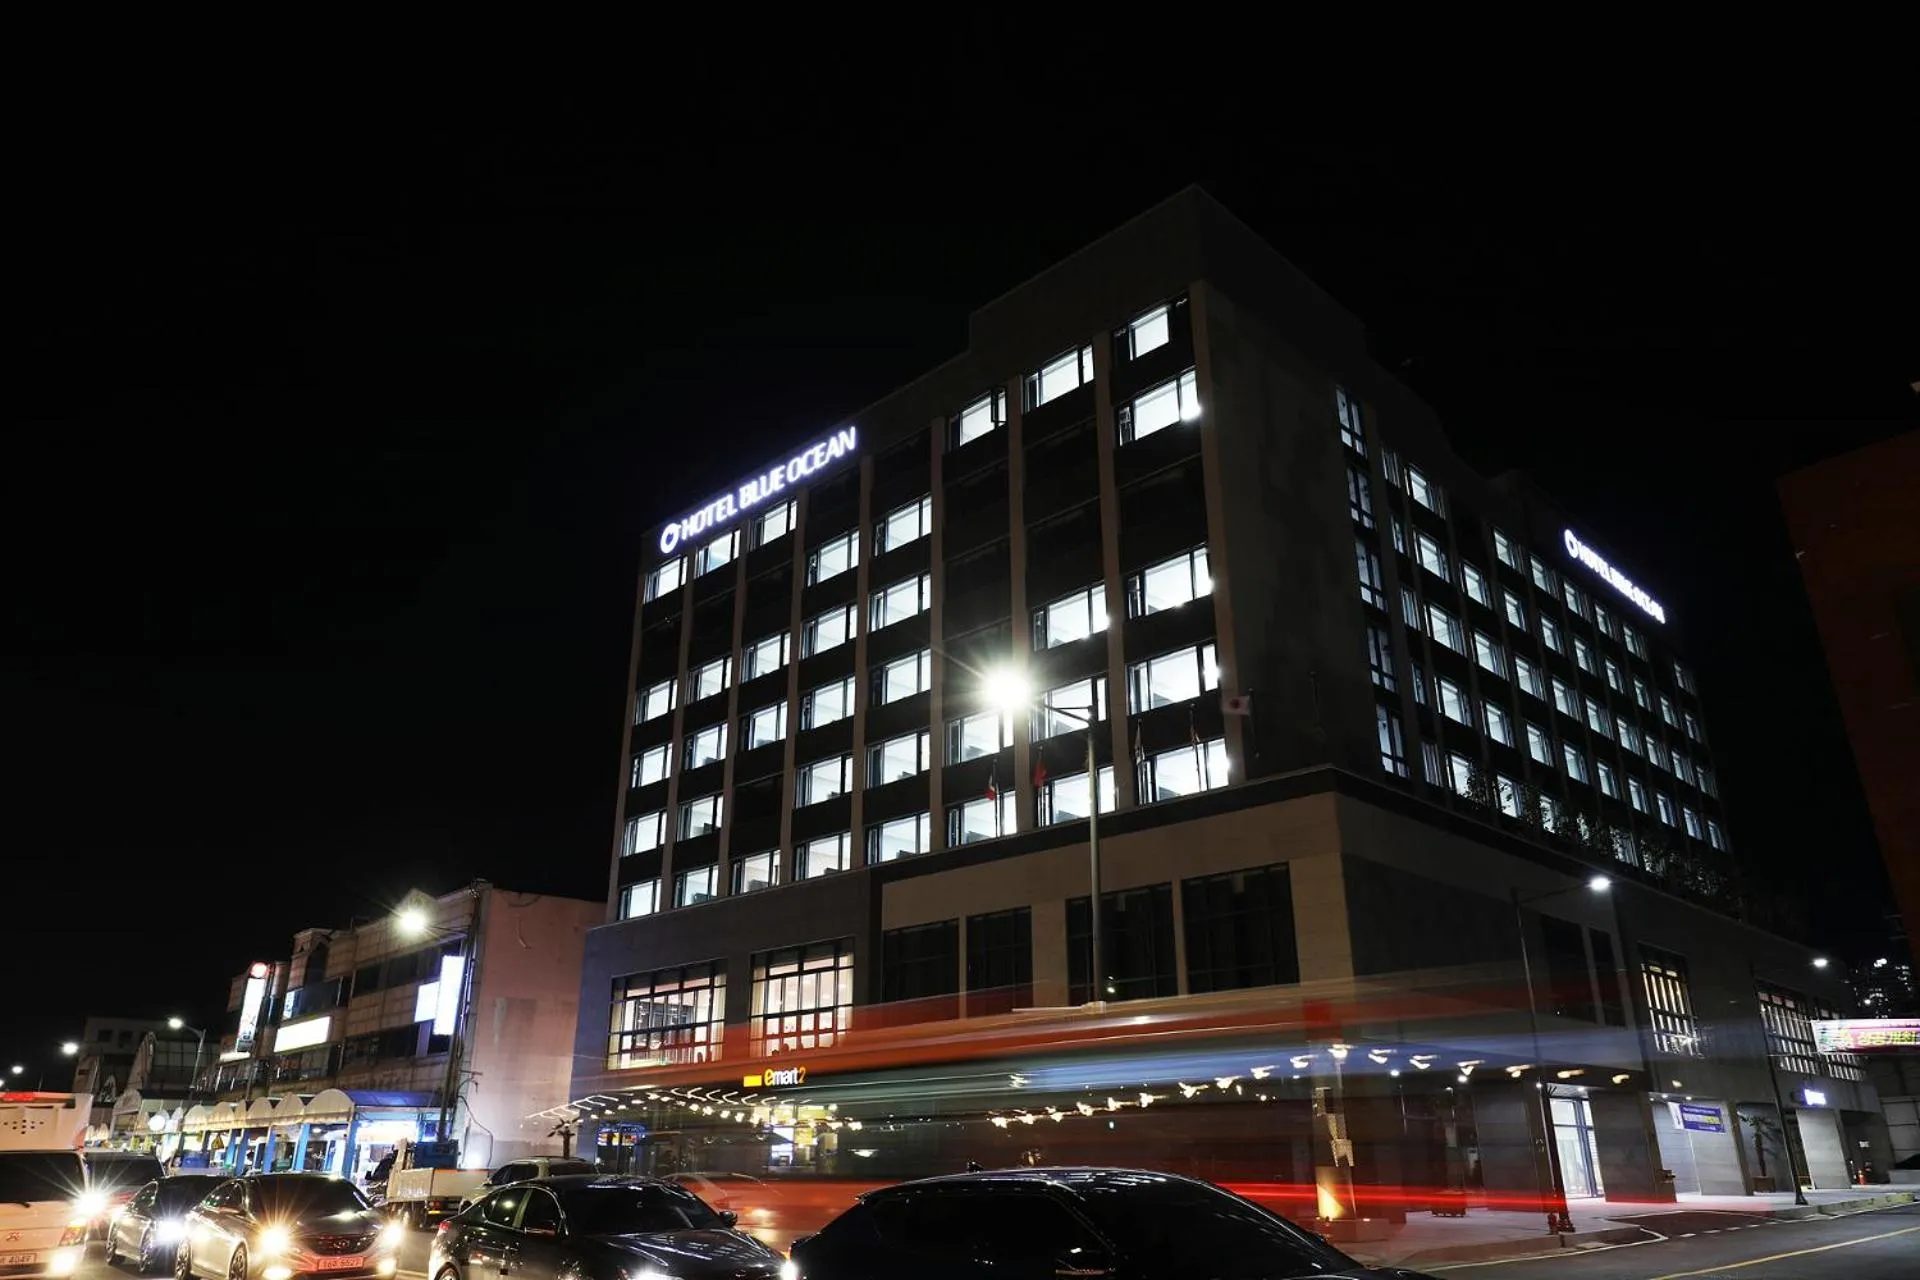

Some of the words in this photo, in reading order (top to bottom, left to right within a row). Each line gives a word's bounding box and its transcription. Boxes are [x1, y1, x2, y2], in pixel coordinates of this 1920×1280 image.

[682, 494, 738, 540] HOTEL
[739, 466, 785, 508] BLUE
[787, 427, 856, 483] OCEAN
